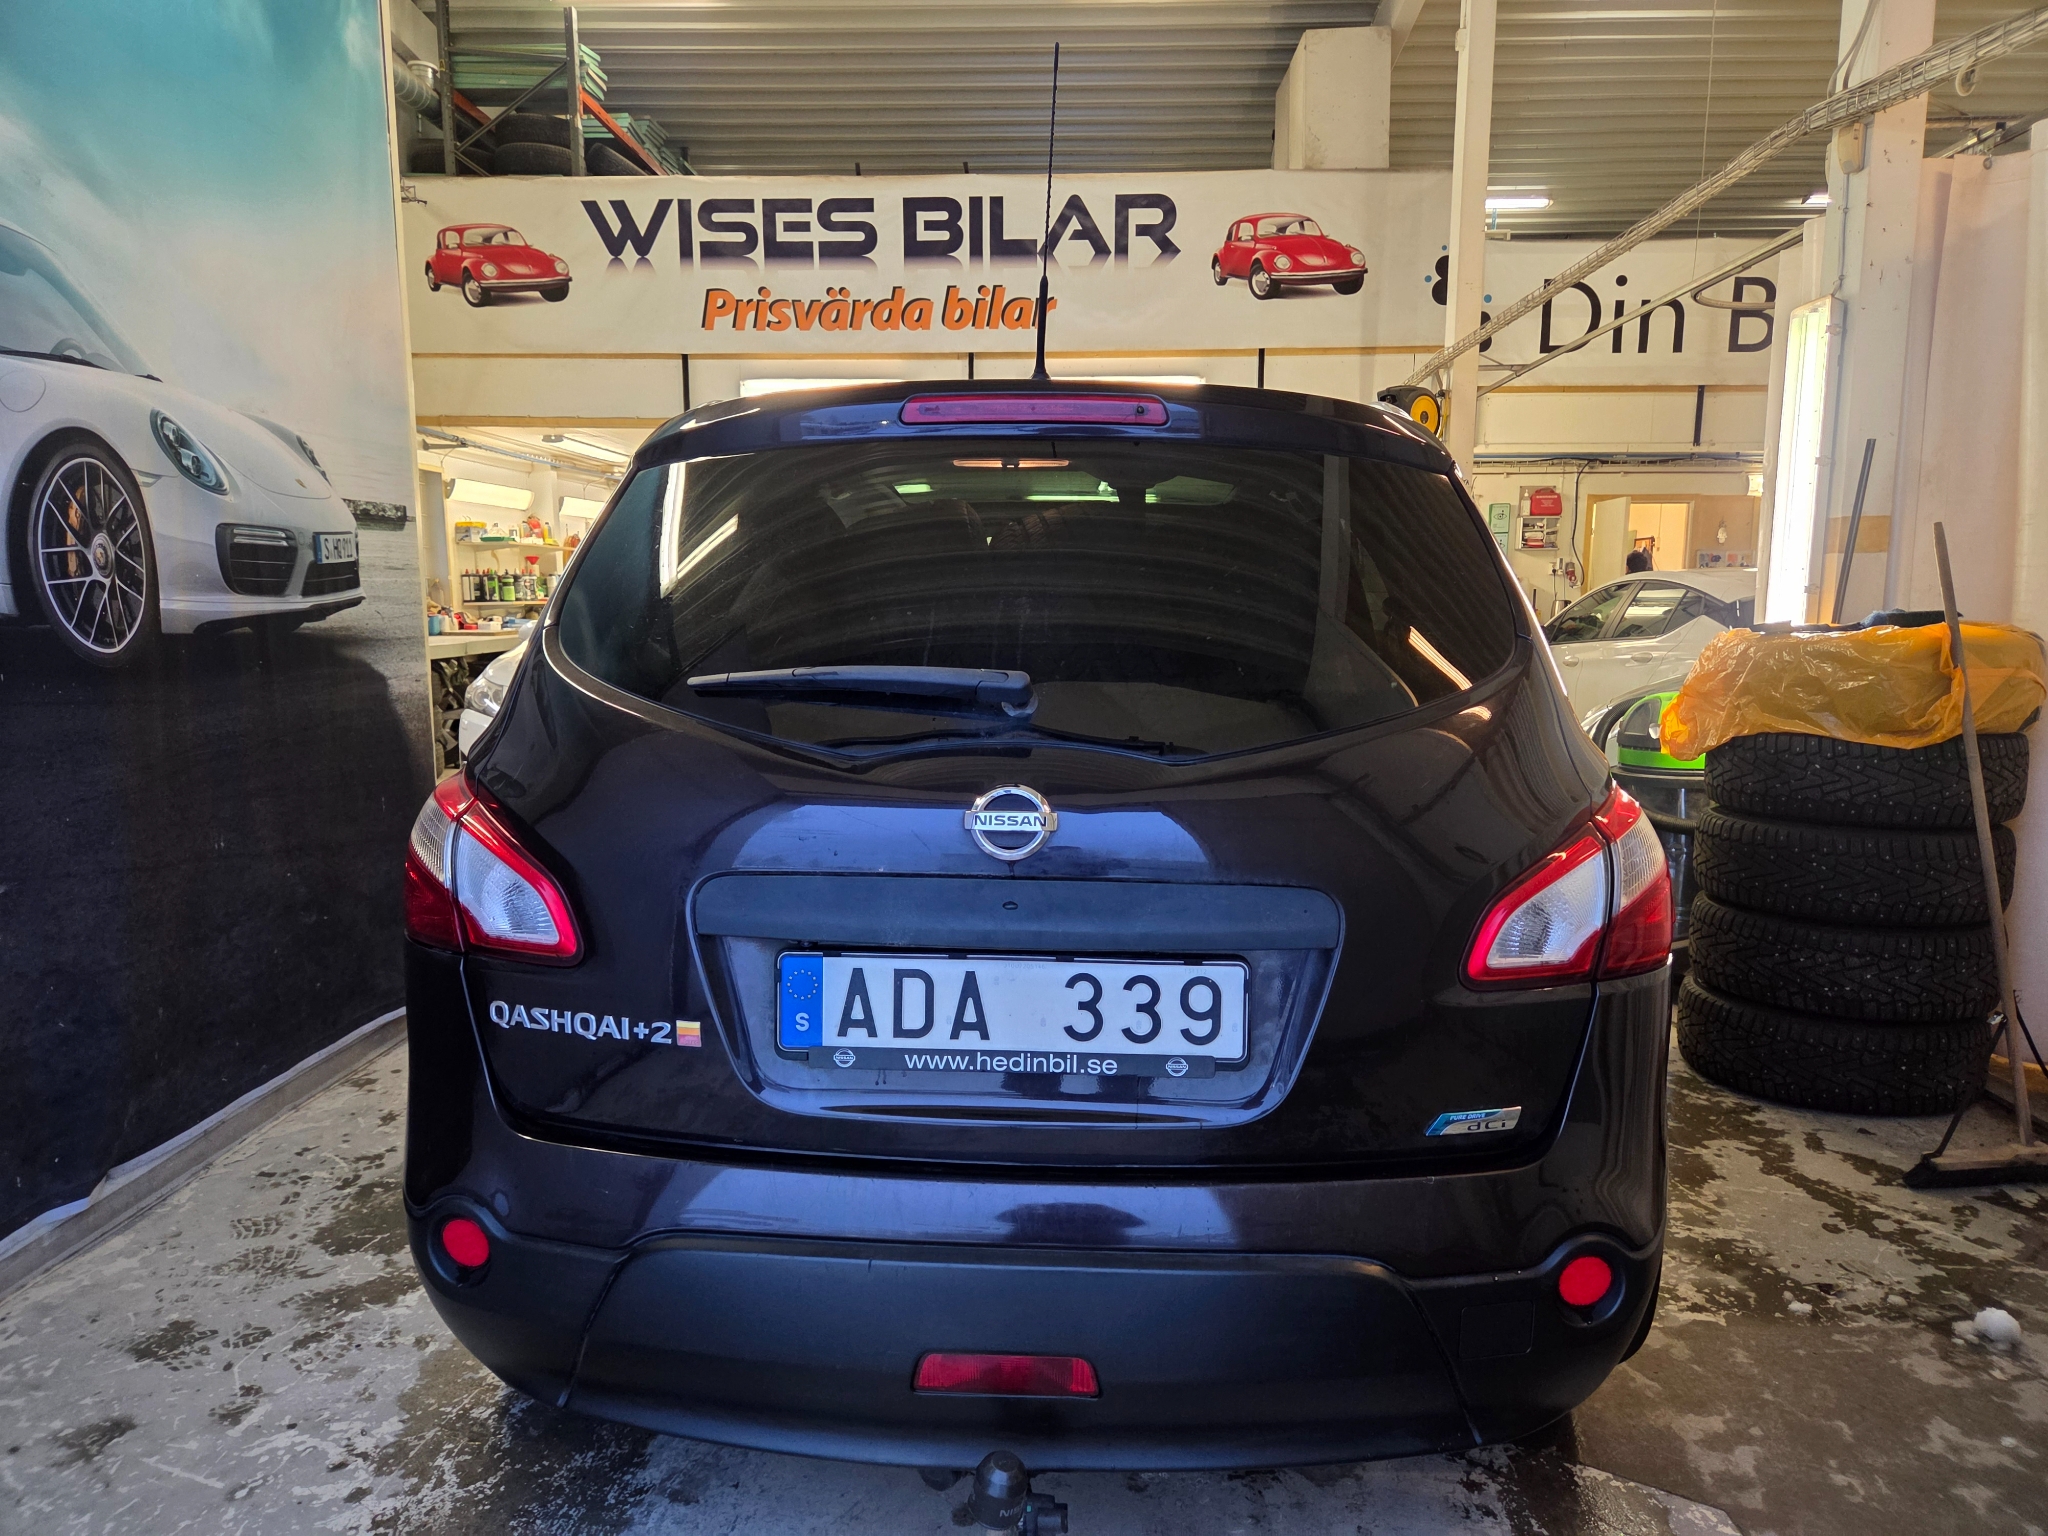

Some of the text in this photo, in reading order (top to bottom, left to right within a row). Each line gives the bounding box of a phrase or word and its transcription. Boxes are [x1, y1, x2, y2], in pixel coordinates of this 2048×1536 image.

[580, 193, 1182, 257] WISES BILAR
[701, 286, 934, 331] Prisvärda
[1539, 275, 1685, 353] Din
[974, 814, 1047, 827] NISSAN
[795, 1012, 810, 1032] S
[837, 967, 1222, 1046] ADA 339
[904, 1052, 1118, 1075] www.hedinbil.se
